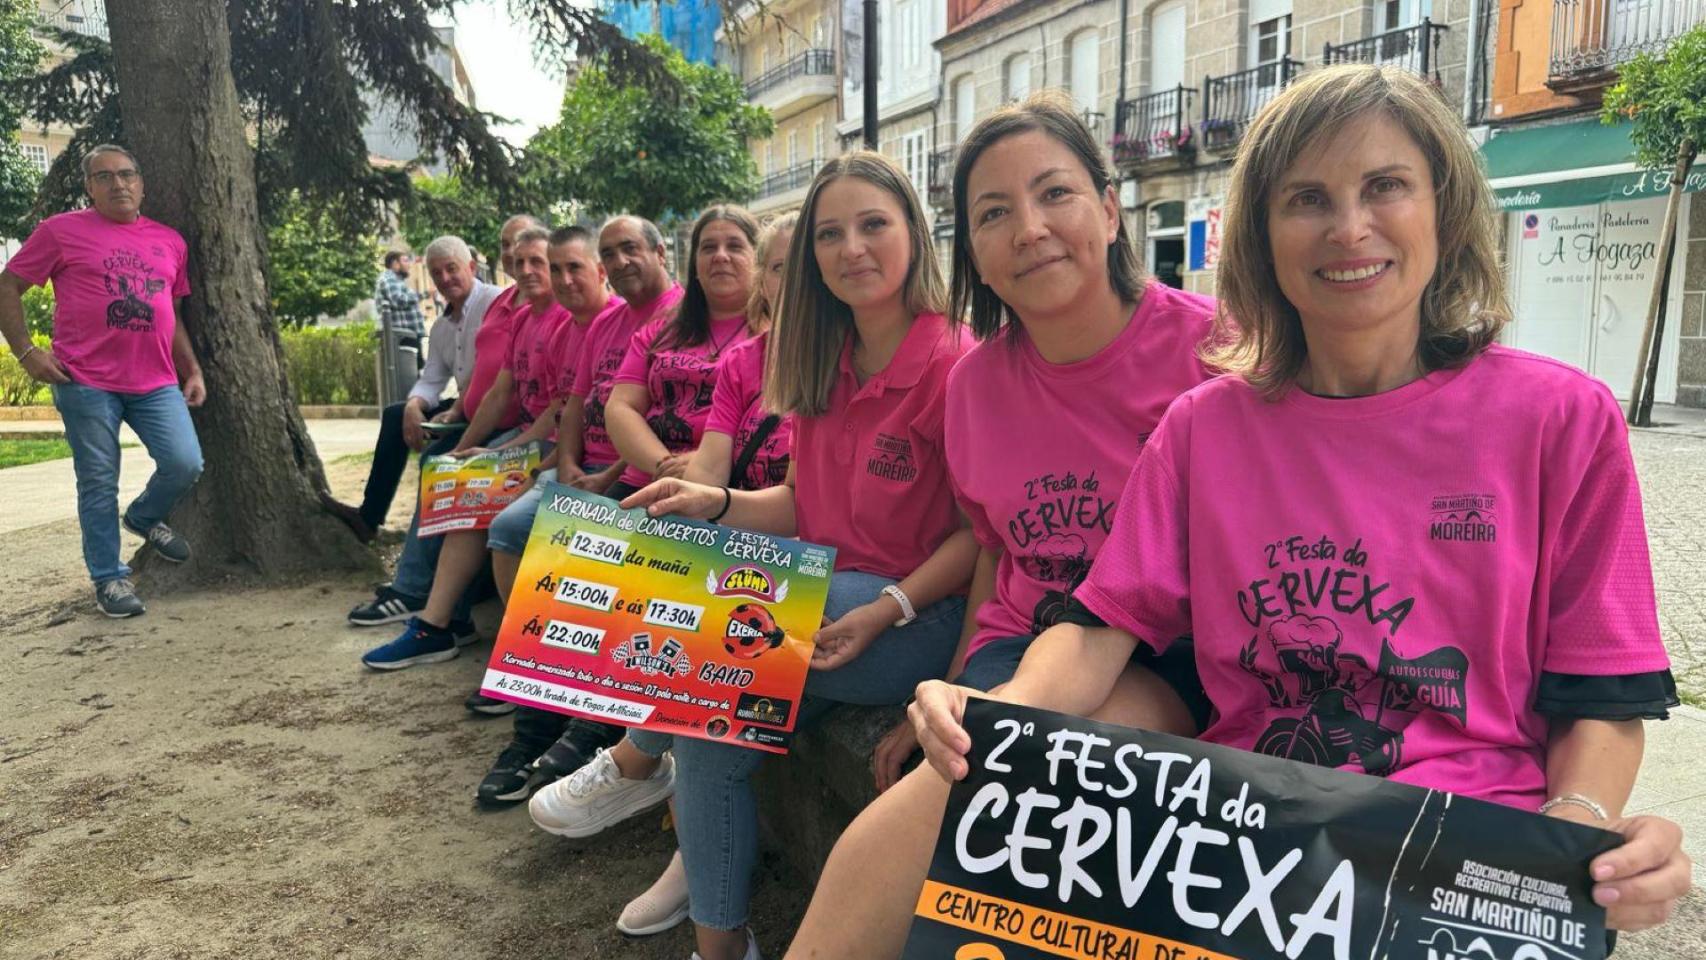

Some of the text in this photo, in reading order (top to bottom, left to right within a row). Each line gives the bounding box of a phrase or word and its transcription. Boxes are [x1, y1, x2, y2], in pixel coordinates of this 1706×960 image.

[1623, 172, 1647, 196] A
[1602, 212, 1649, 228] Pastelería
[1538, 233, 1656, 270] A Fogaza
[867, 458, 917, 482] MOREIRA
[1041, 471, 1078, 493] Festa
[1082, 470, 1099, 493] da
[549, 493, 719, 547] XORNADA de CONCERTOS
[1009, 495, 1114, 548] CERVEX
[1431, 522, 1496, 542] MOREIRA
[550, 525, 692, 576] Ás 12:30h da mañá
[723, 540, 792, 568] CERVEXA
[741, 532, 770, 547] FESTA
[1286, 535, 1336, 562] Festa
[1343, 537, 1368, 567] da
[535, 571, 557, 593] Ás
[561, 580, 609, 607] 15:00h
[627, 599, 643, 615] ás
[650, 602, 696, 627] 17:30h
[1237, 566, 1415, 636] CERVEXA
[522, 615, 600, 651] Ás 22:00h
[502, 652, 535, 670] Xornada
[537, 663, 575, 679] amenizada
[577, 667, 593, 683] todo
[594, 676, 600, 684] o
[644, 684, 656, 696] DJ
[655, 687, 671, 700] pola
[698, 698, 718, 711] cargo
[719, 700, 730, 710] de
[699, 662, 753, 687] BAND
[496, 675, 507, 688] Ás
[509, 679, 542, 697] 23:00h
[544, 687, 567, 703] tirada
[569, 694, 580, 706] de
[582, 697, 605, 714] Fogos
[1417, 682, 1462, 708] GUÍA
[983, 719, 1266, 830] 2ª FESTA da
[955, 782, 1356, 960] CERVEXA
[1462, 859, 1521, 884] ASOCIACIÓN
[1454, 872, 1572, 914] RECREATIVA E DEPORTIVA
[936, 890, 1024, 934] CENTRO
[1030, 914, 1140, 960] CULTURAL
[1430, 887, 1586, 949] SAN MARTIÑO DE
